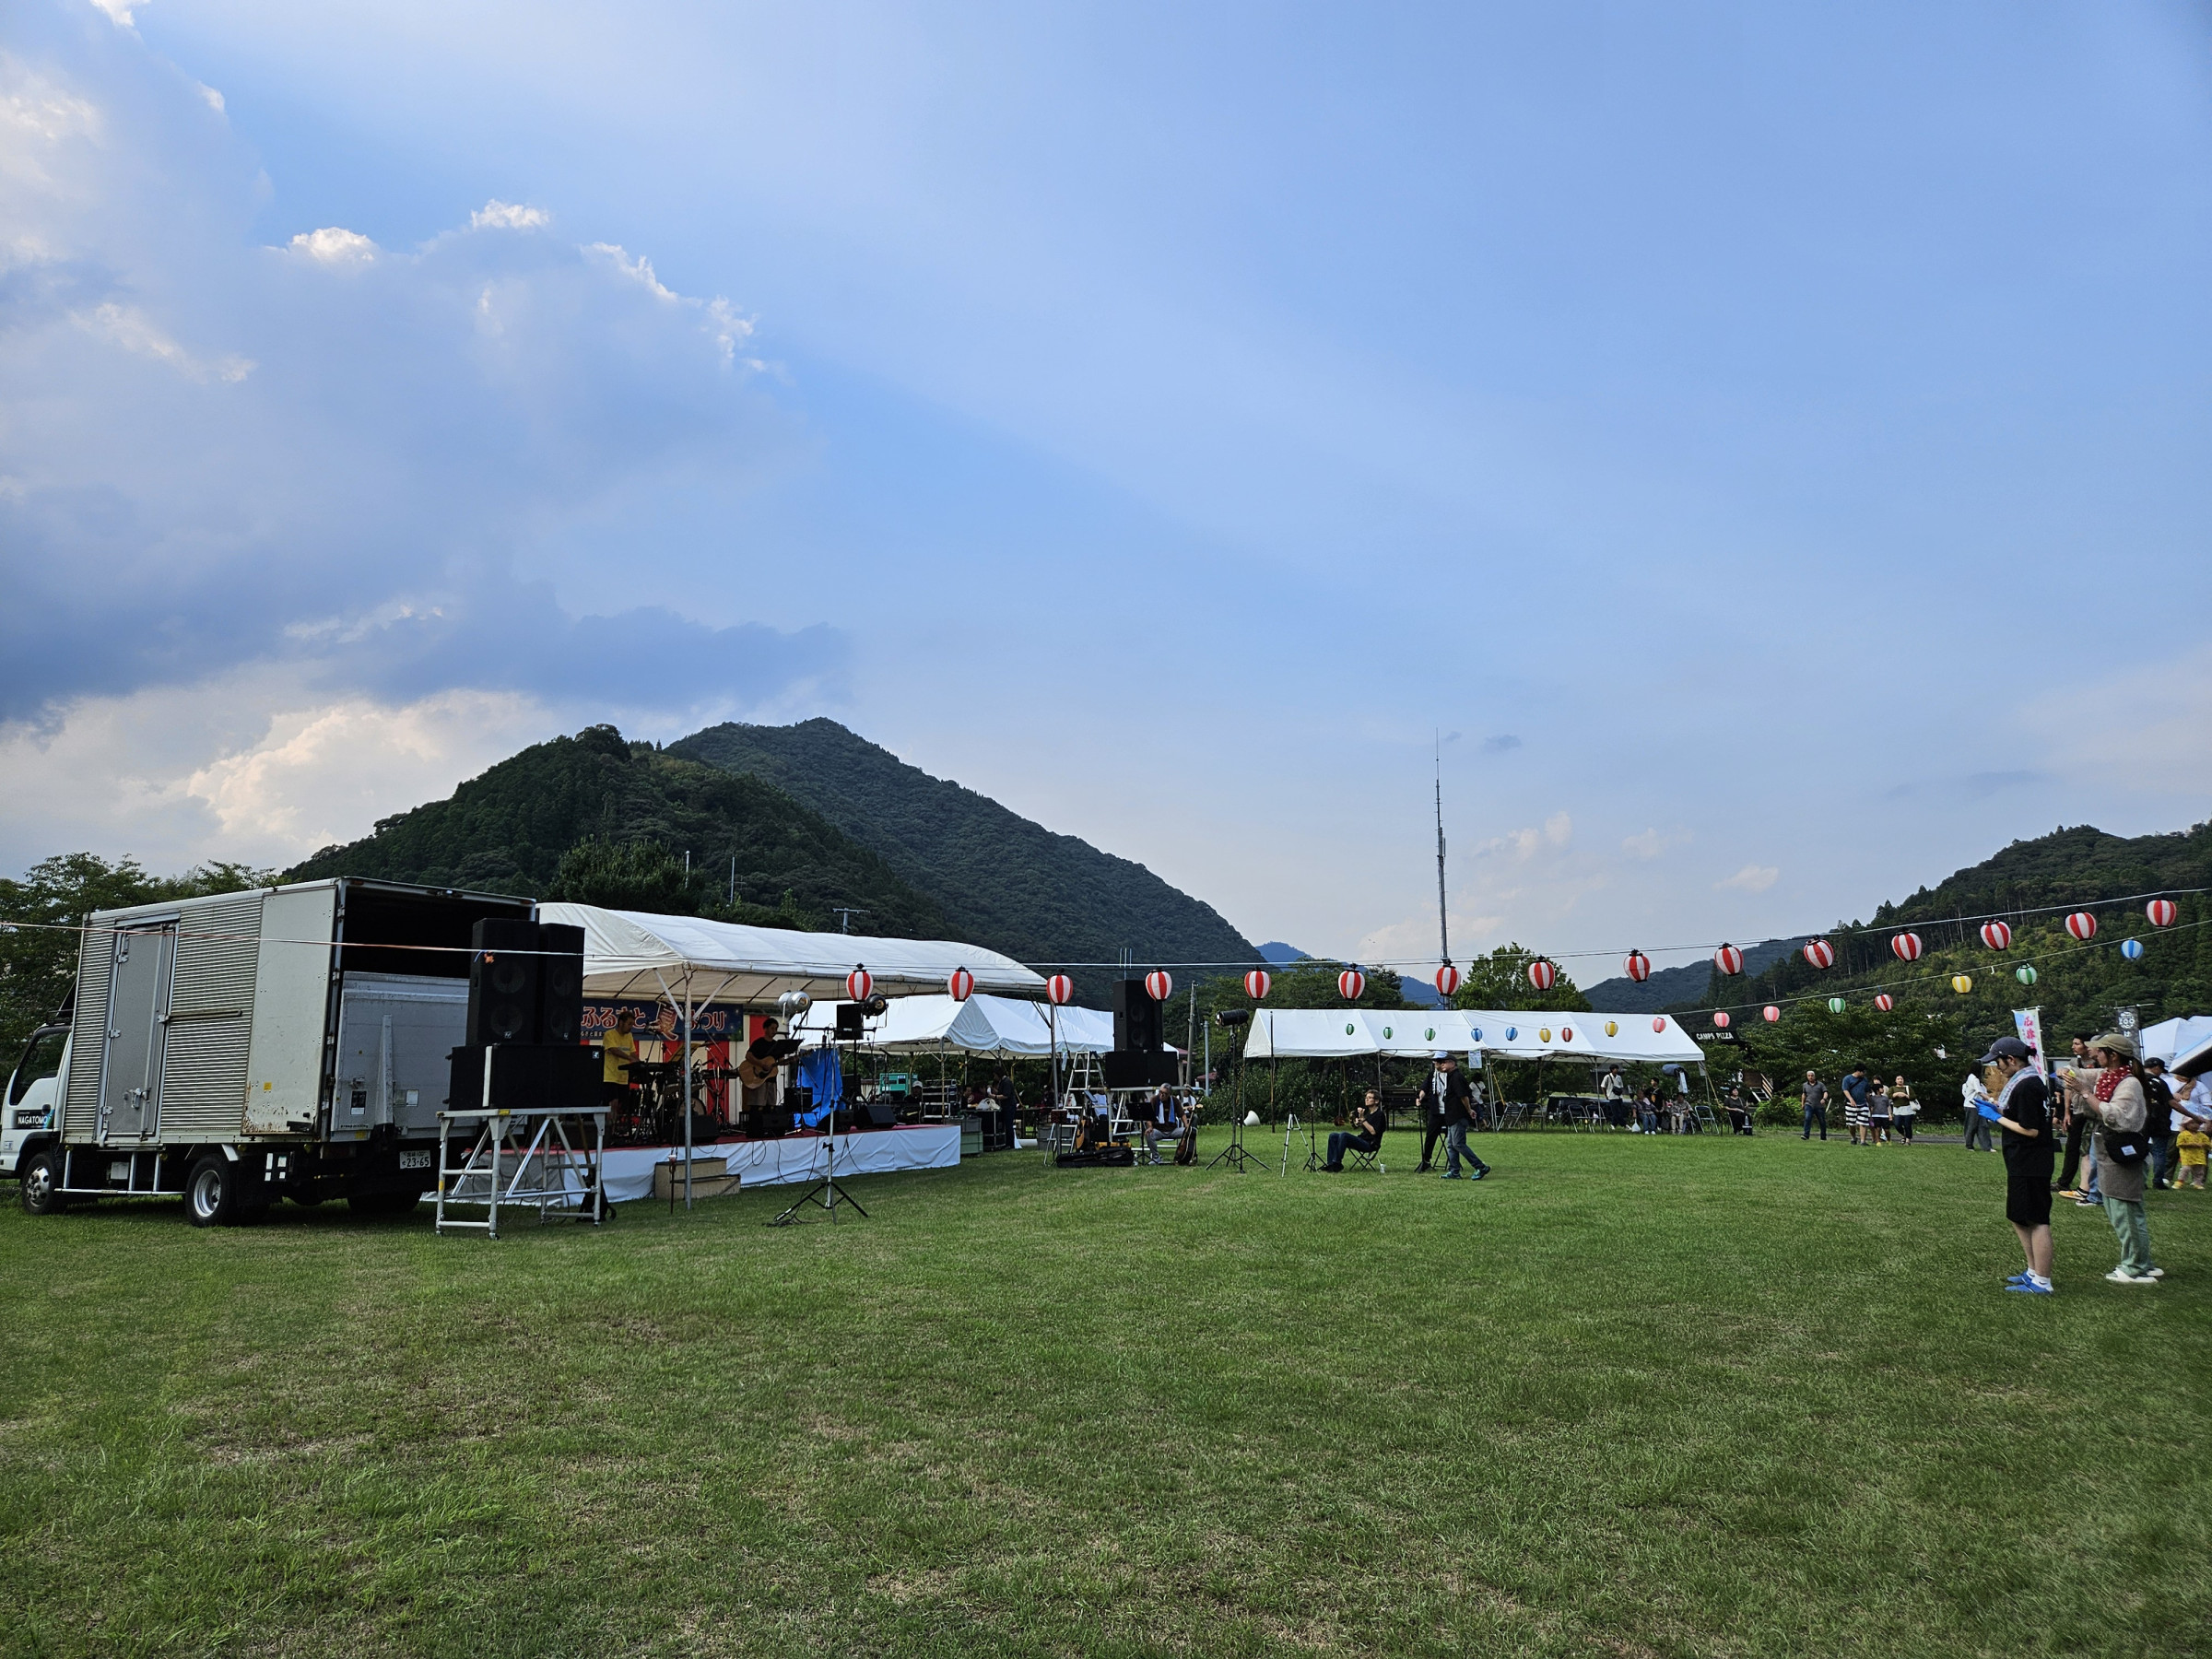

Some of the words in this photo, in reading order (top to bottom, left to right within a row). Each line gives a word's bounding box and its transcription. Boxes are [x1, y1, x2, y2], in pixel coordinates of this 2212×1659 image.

[1696, 1032, 1715, 1041] CAMPS
[1715, 1031, 1735, 1040] PIZZA
[18, 1115, 48, 1124] NAGATOMO
[406, 1156, 429, 1168] 23-65
